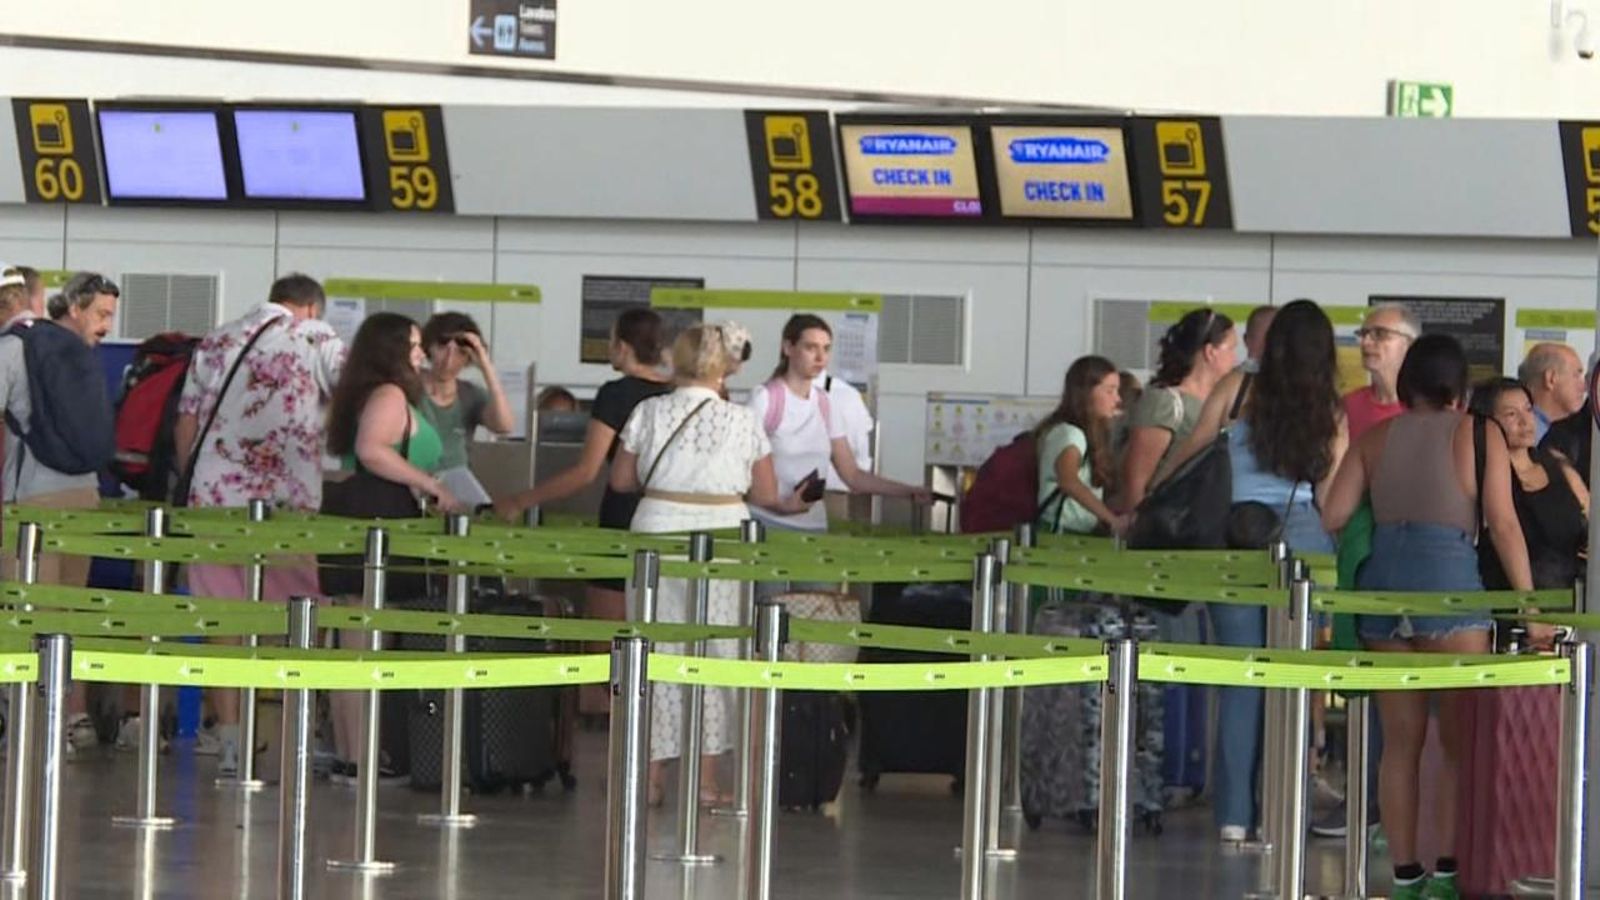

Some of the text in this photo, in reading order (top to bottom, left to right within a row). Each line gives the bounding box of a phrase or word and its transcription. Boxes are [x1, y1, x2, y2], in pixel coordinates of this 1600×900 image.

[874, 137, 953, 151] RYANAIR
[1024, 141, 1104, 160] RYANAIR
[35, 158, 84, 200] 60
[389, 165, 439, 209] 59
[872, 168, 952, 186] CHECK IN
[1024, 180, 1105, 202] CHECK IN
[768, 172, 823, 218] 58
[1161, 179, 1212, 225] 57
